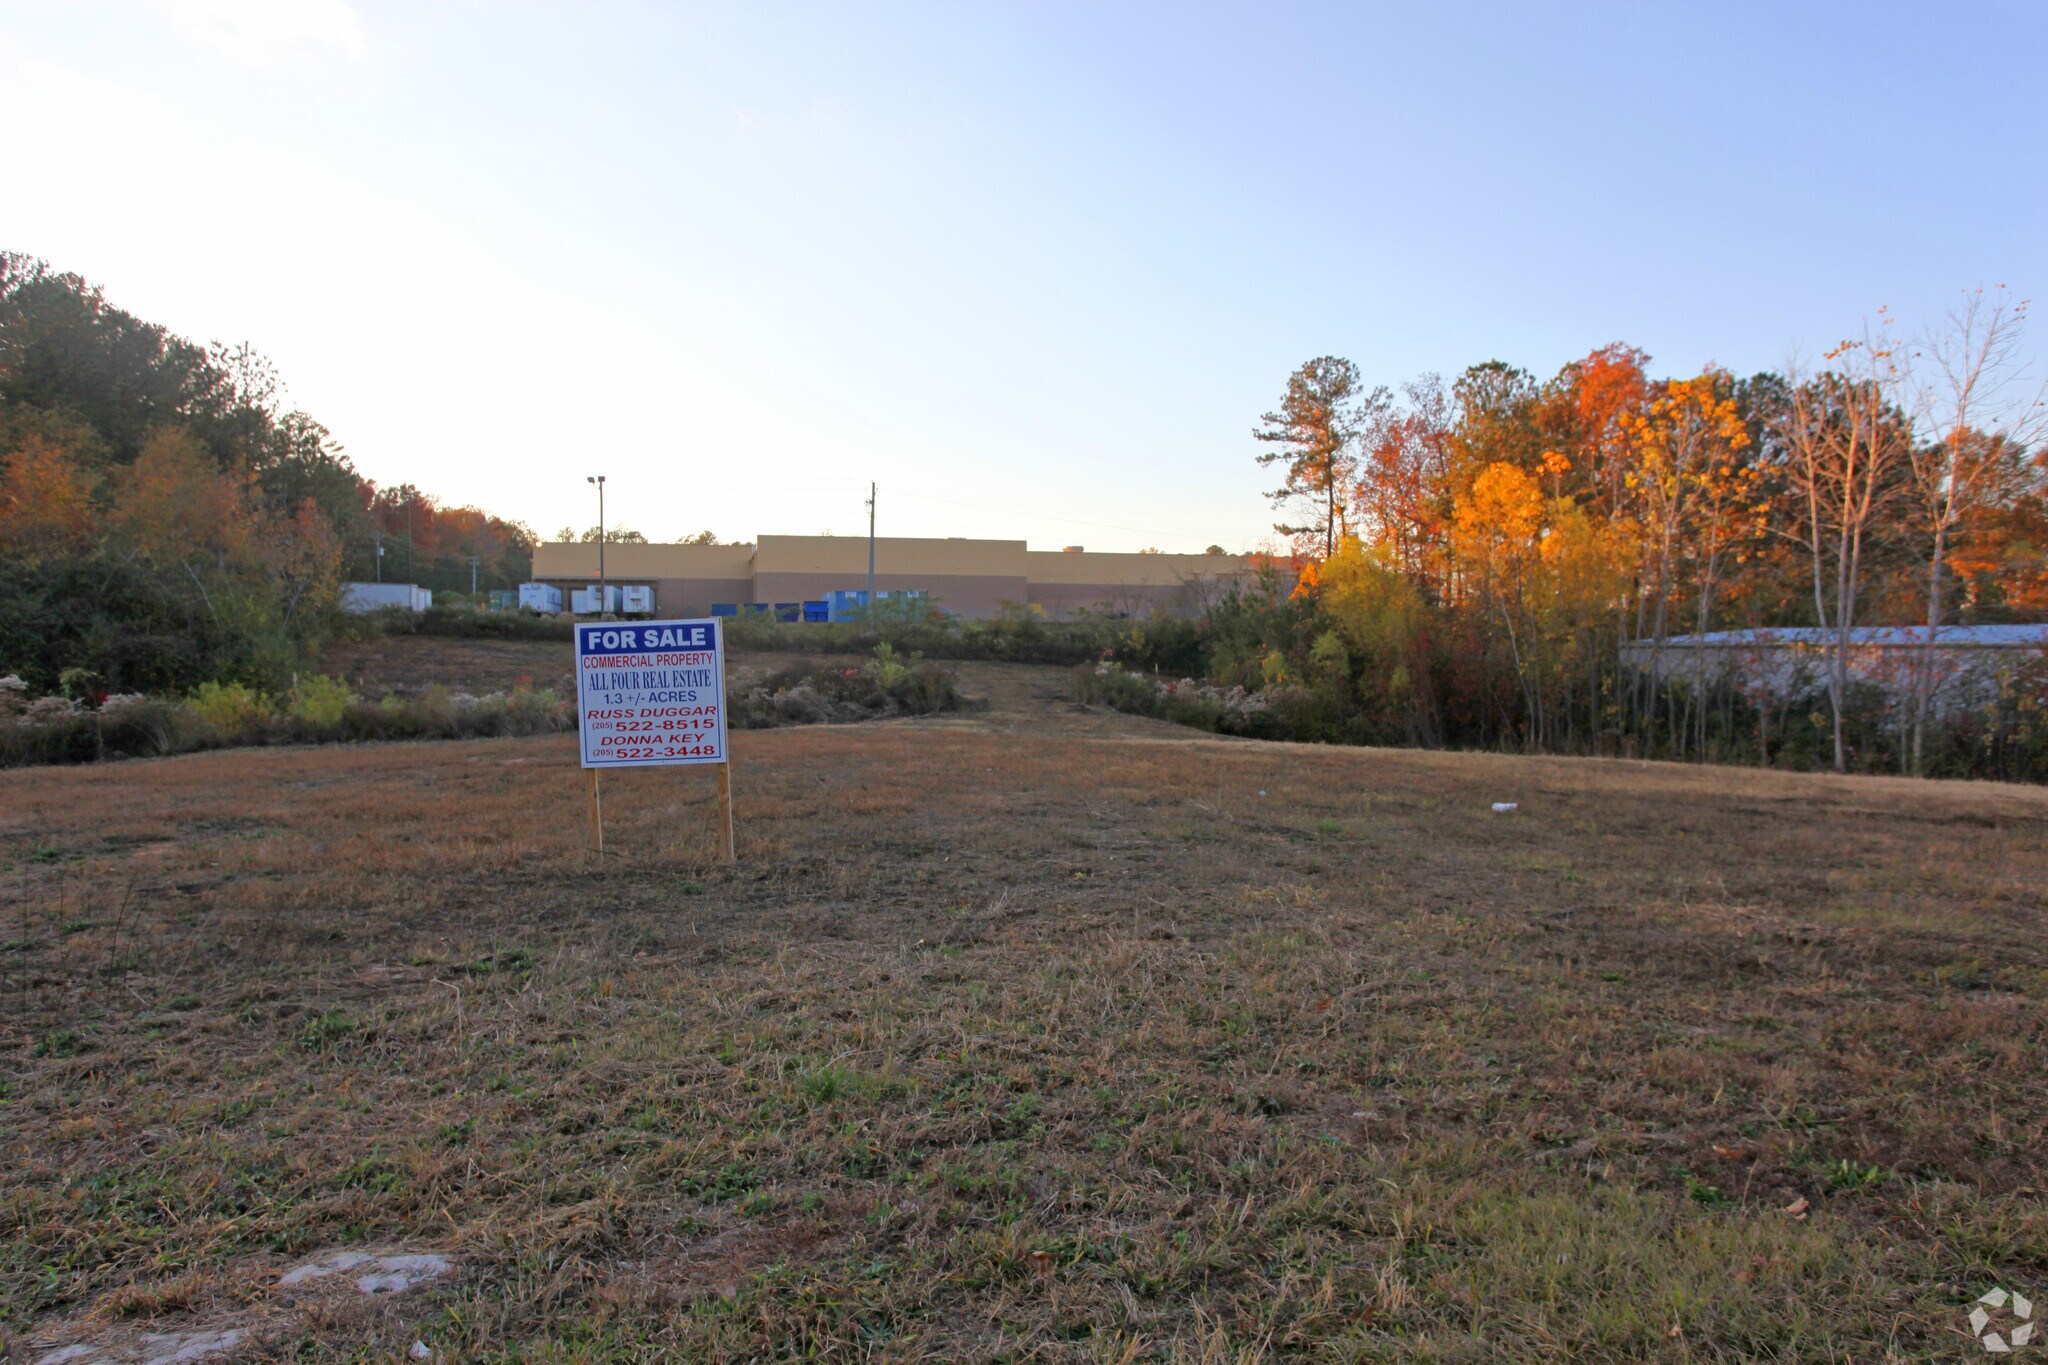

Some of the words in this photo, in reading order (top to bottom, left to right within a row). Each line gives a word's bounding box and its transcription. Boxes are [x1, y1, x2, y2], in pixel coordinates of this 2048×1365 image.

[588, 631, 637, 649] FOR
[644, 628, 706, 648] SALE
[584, 656, 653, 669] COMMERCIAL
[657, 653, 713, 666] PROPERTY
[589, 672, 609, 690] ALL
[612, 671, 640, 690] FOUR
[643, 670, 670, 688] REAL
[673, 669, 711, 687] ESTATE
[604, 694, 622, 704] 1.3
[649, 691, 697, 703] ACRES
[588, 709, 634, 719] RUSS
[640, 706, 717, 717] DUGGAR
[616, 719, 715, 732] 522-8515
[601, 736, 663, 746] DONNA
[669, 734, 705, 743] KEY
[593, 749, 613, 757] (205)
[616, 746, 715, 758] 522-3448
